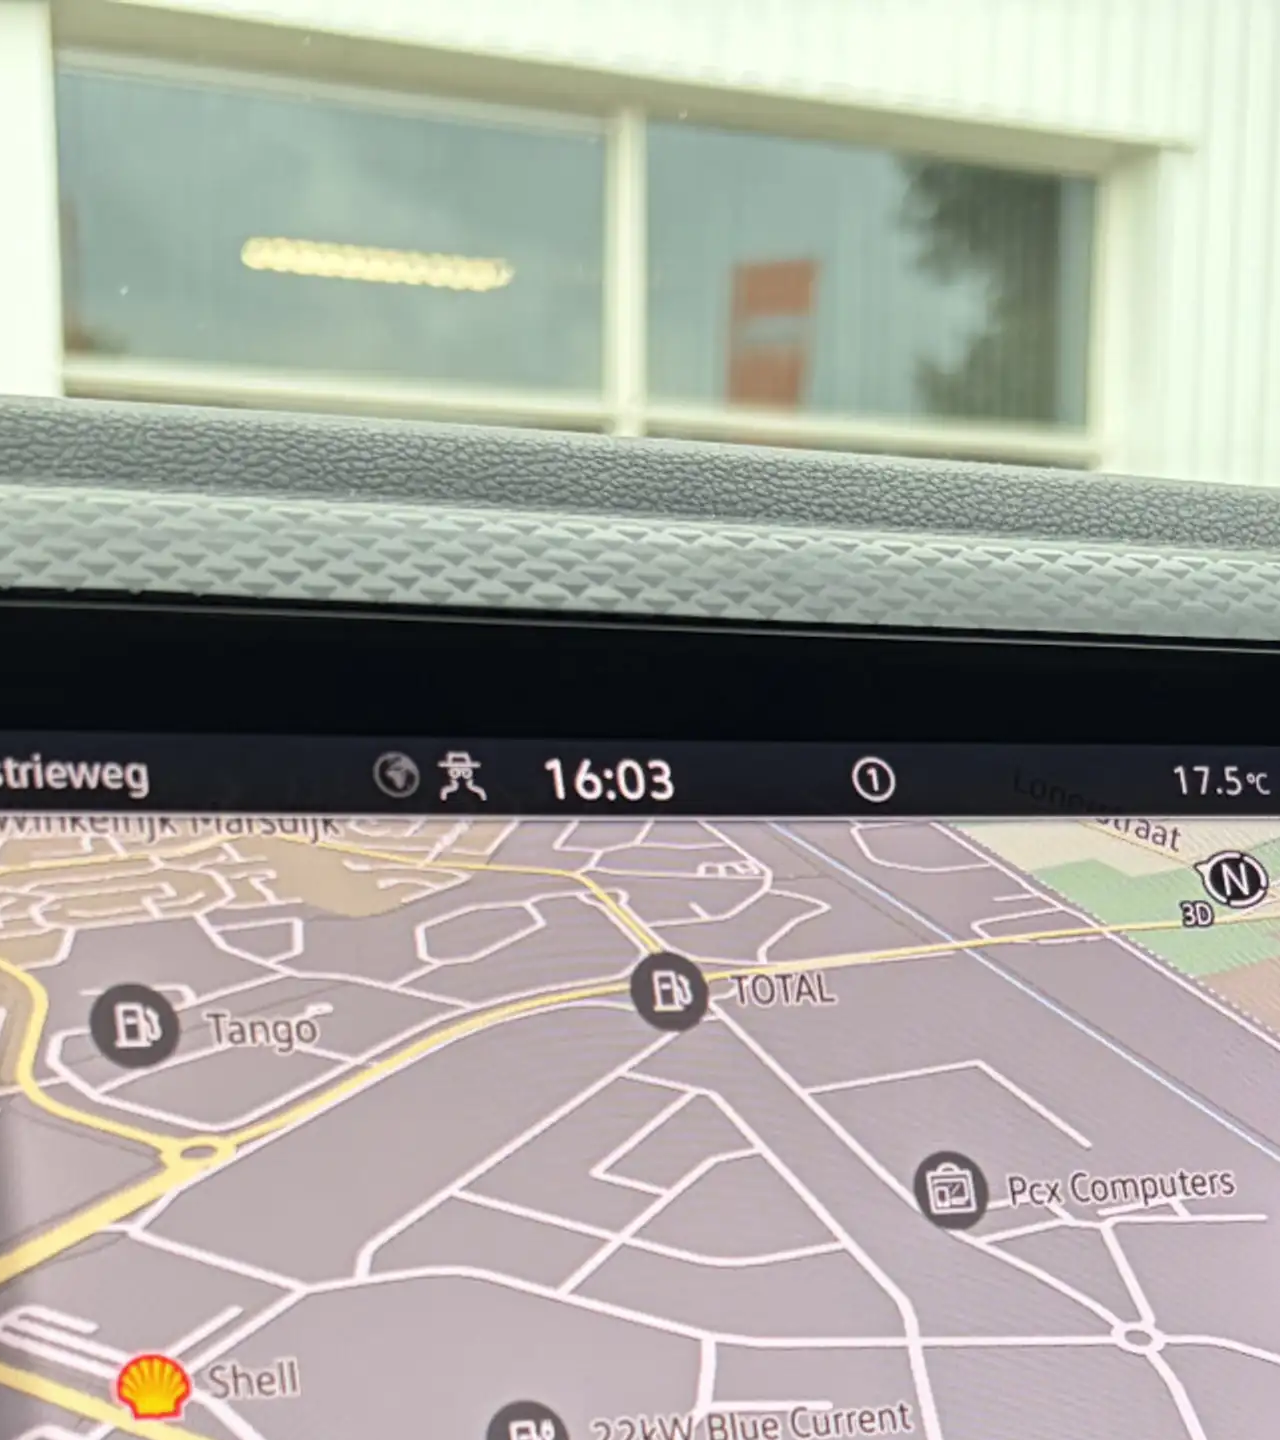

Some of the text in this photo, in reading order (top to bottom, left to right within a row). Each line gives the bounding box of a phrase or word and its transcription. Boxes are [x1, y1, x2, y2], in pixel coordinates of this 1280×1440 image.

[544, 758, 674, 801] 16:03
[1173, 765, 1271, 796] 17.5°C
[1224, 863, 1249, 894] N
[1182, 903, 1214, 926] 3D
[731, 972, 837, 1005] TOTAL
[207, 1011, 318, 1055] Tango
[1008, 1167, 1236, 1208] Pcx Computers
[208, 1361, 300, 1400] Shell
[790, 1402, 913, 1440] Current
